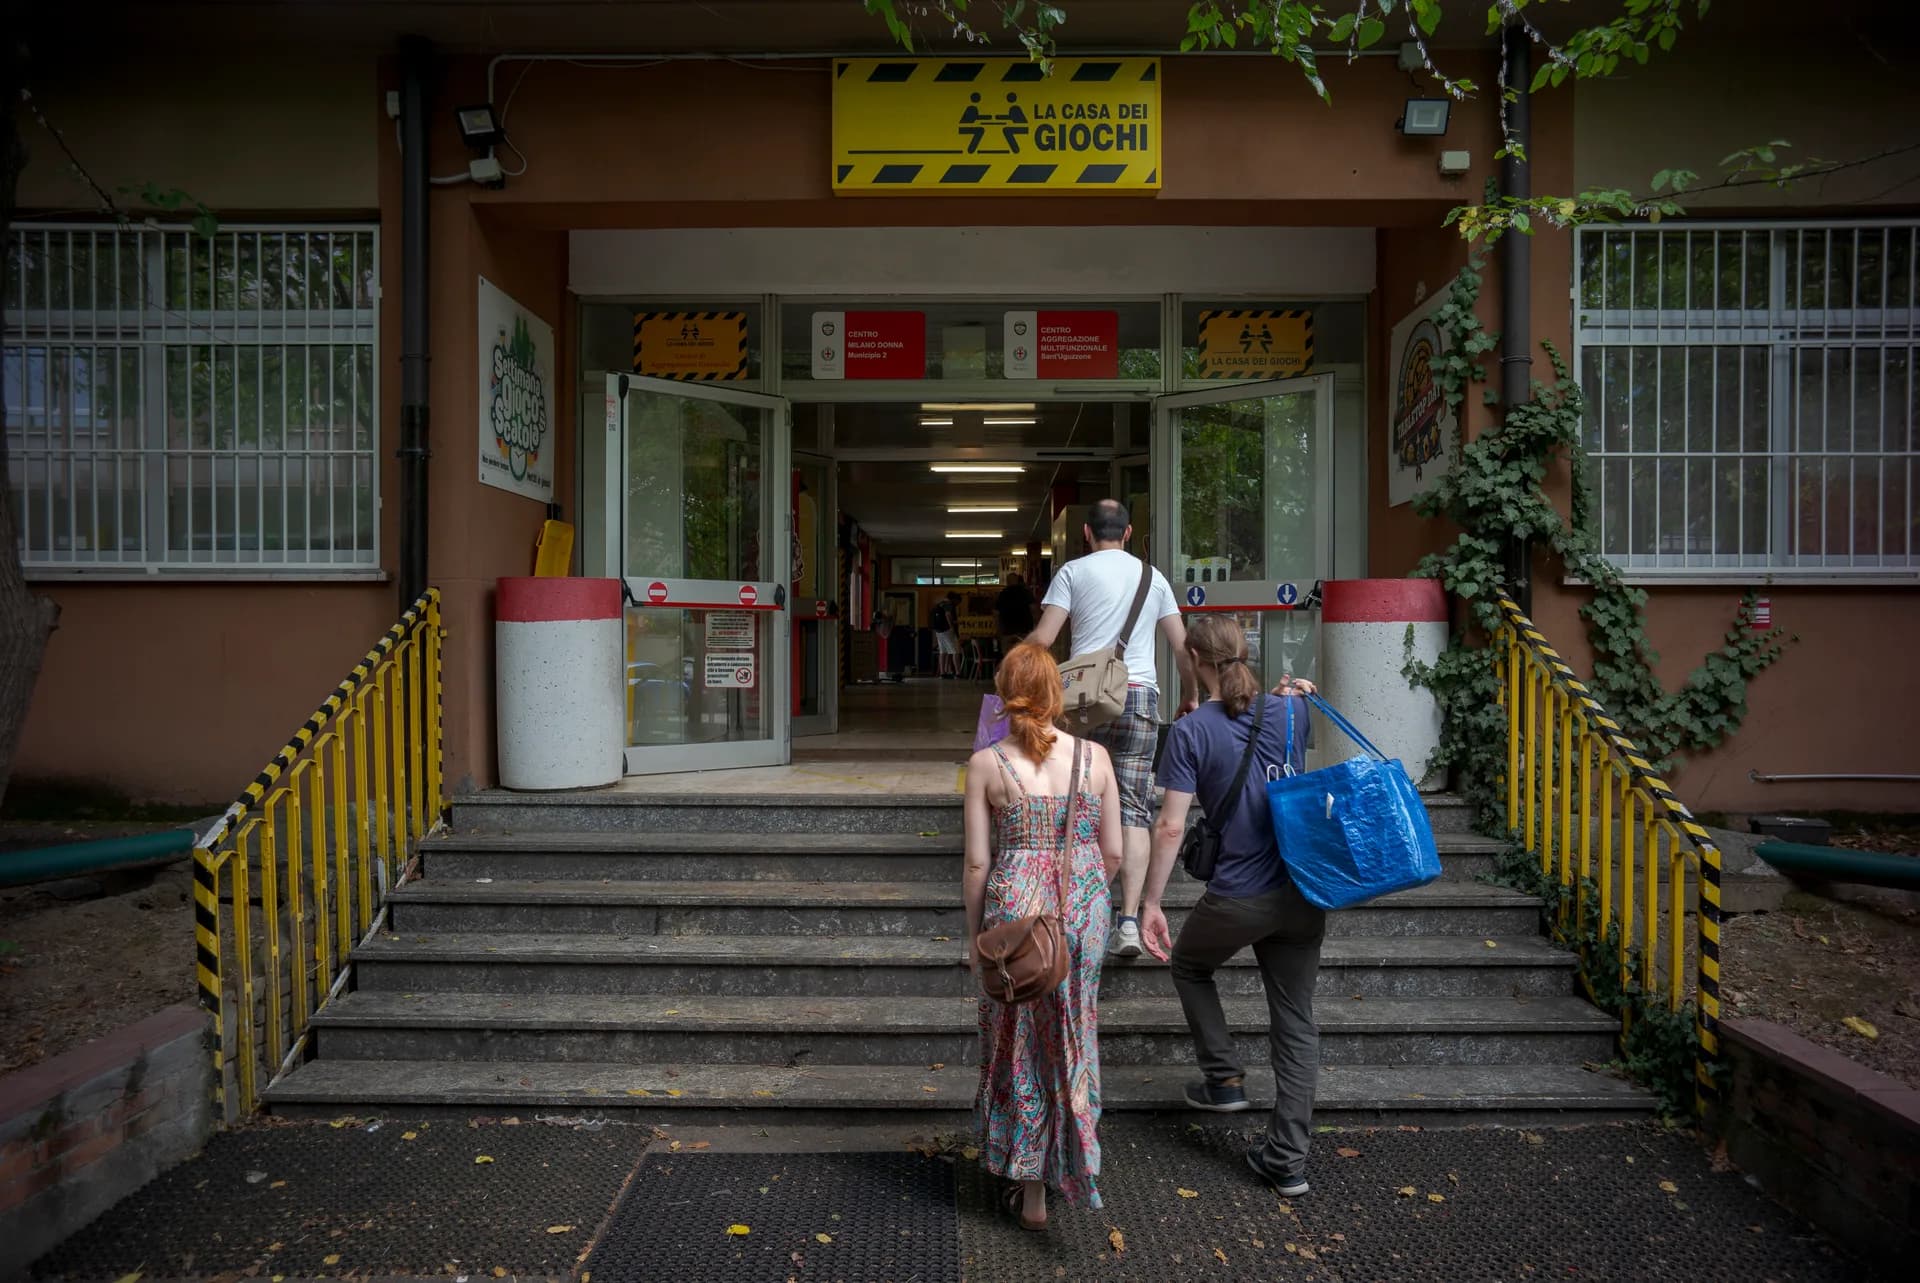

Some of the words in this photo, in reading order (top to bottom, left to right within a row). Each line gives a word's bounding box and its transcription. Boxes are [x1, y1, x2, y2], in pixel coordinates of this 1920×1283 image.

[1034, 103, 1056, 119] LA
[1062, 103, 1110, 119] CASA
[1118, 103, 1148, 119] DEI
[1034, 123, 1148, 151] GIOCHI
[848, 341, 876, 349] MILANO
[877, 341, 904, 349] DONNA
[848, 352, 881, 360] Municipio
[1270, 357, 1300, 365] GIOCHI
